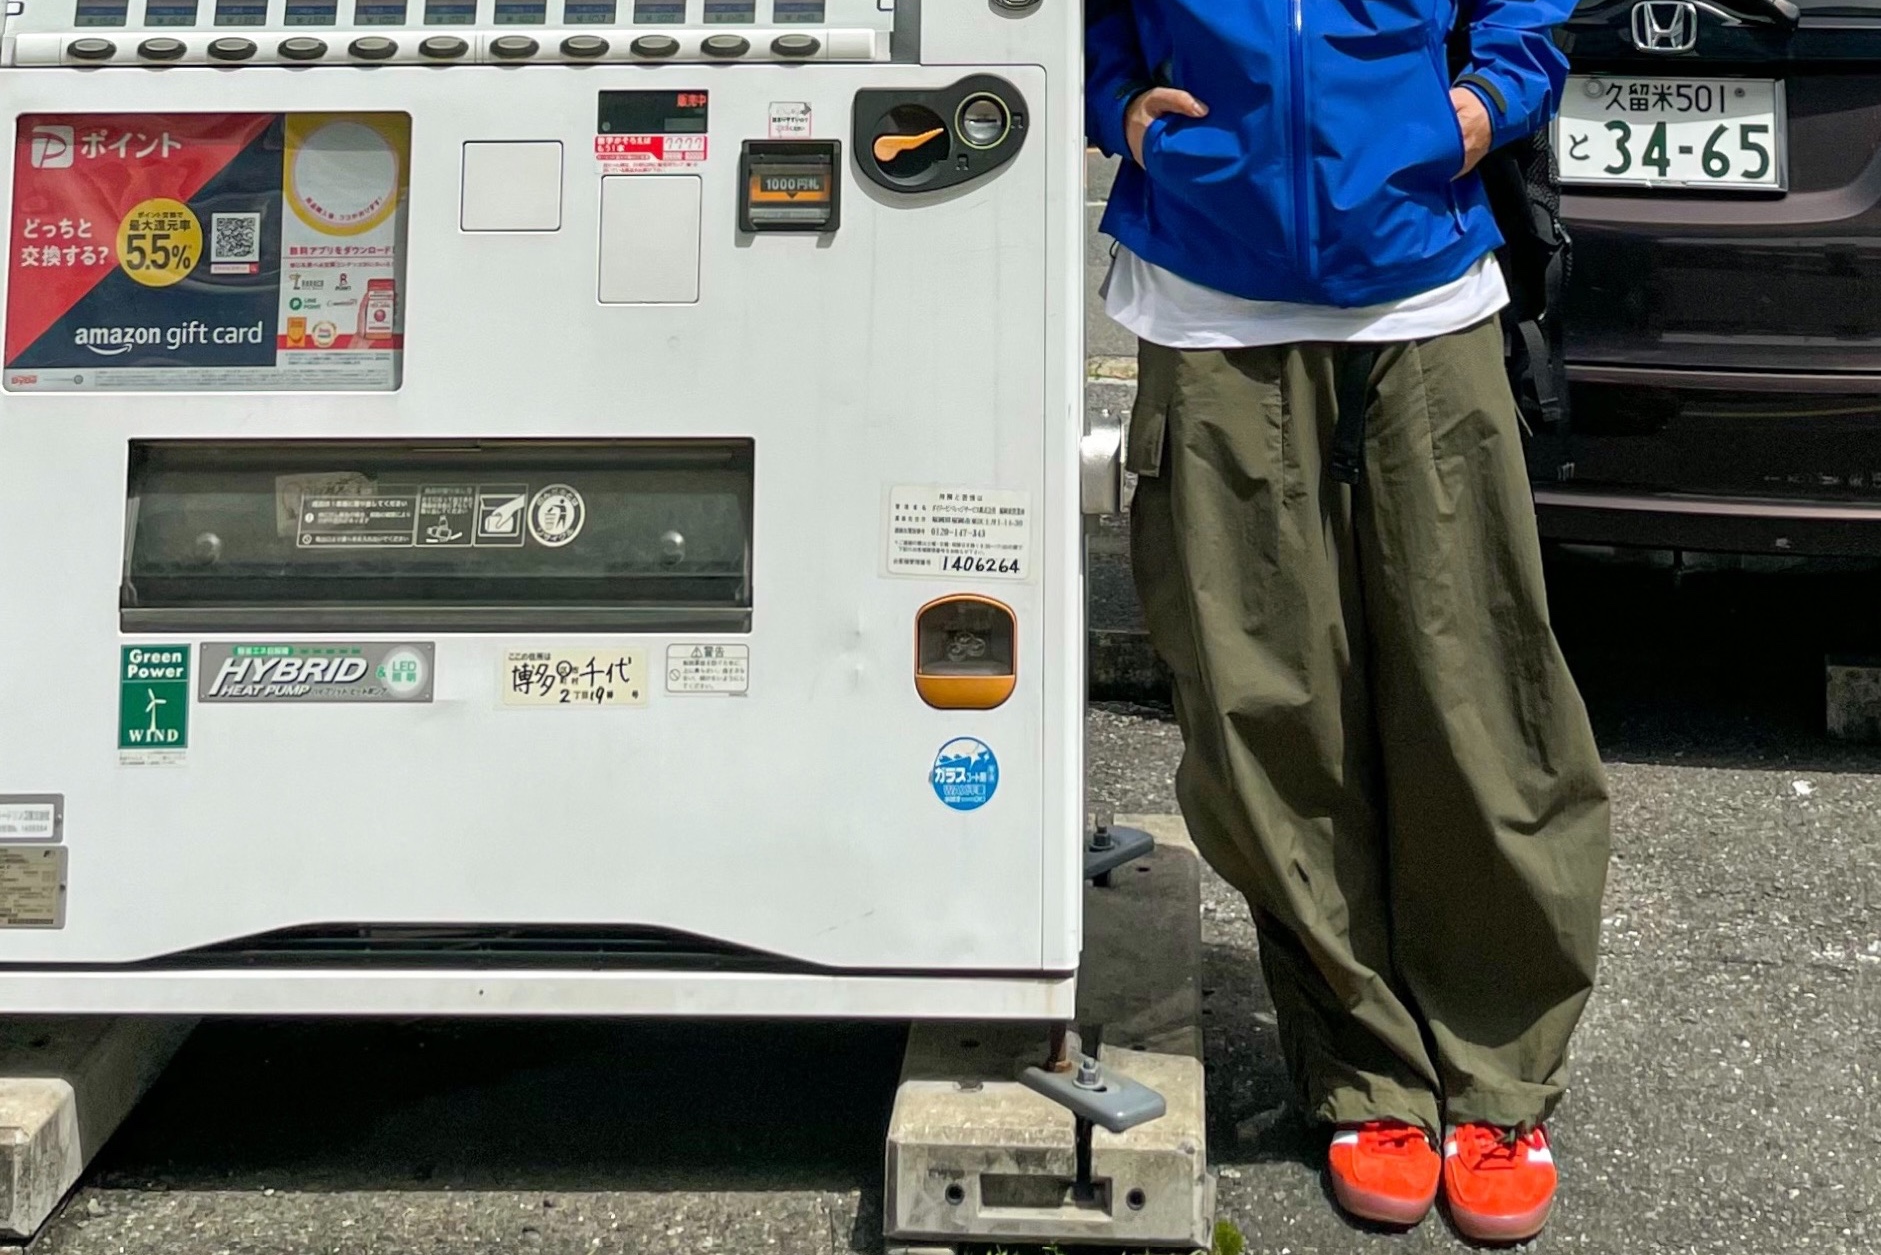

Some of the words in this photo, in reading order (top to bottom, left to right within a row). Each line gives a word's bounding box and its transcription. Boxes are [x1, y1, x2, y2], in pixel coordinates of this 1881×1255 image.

[81, 129, 182, 159] ポイント
[766, 177, 820, 190] 1000円札
[23, 218, 93, 239] どっちと
[21, 245, 109, 267] 交換する?
[74, 326, 166, 346] amazon
[166, 320, 209, 350] gift
[212, 320, 263, 344] card
[943, 556, 1020, 573] 1406264
[129, 648, 182, 664] Green
[128, 664, 184, 679] Power
[391, 660, 417, 671] LED
[208, 657, 369, 696] HYBRID
[512, 663, 556, 697] 博多
[579, 656, 632, 687] 千代
[220, 684, 265, 696] HEAT
[267, 684, 311, 696] PUMP
[129, 728, 180, 743] WIND
[935, 767, 966, 783] ガラス
